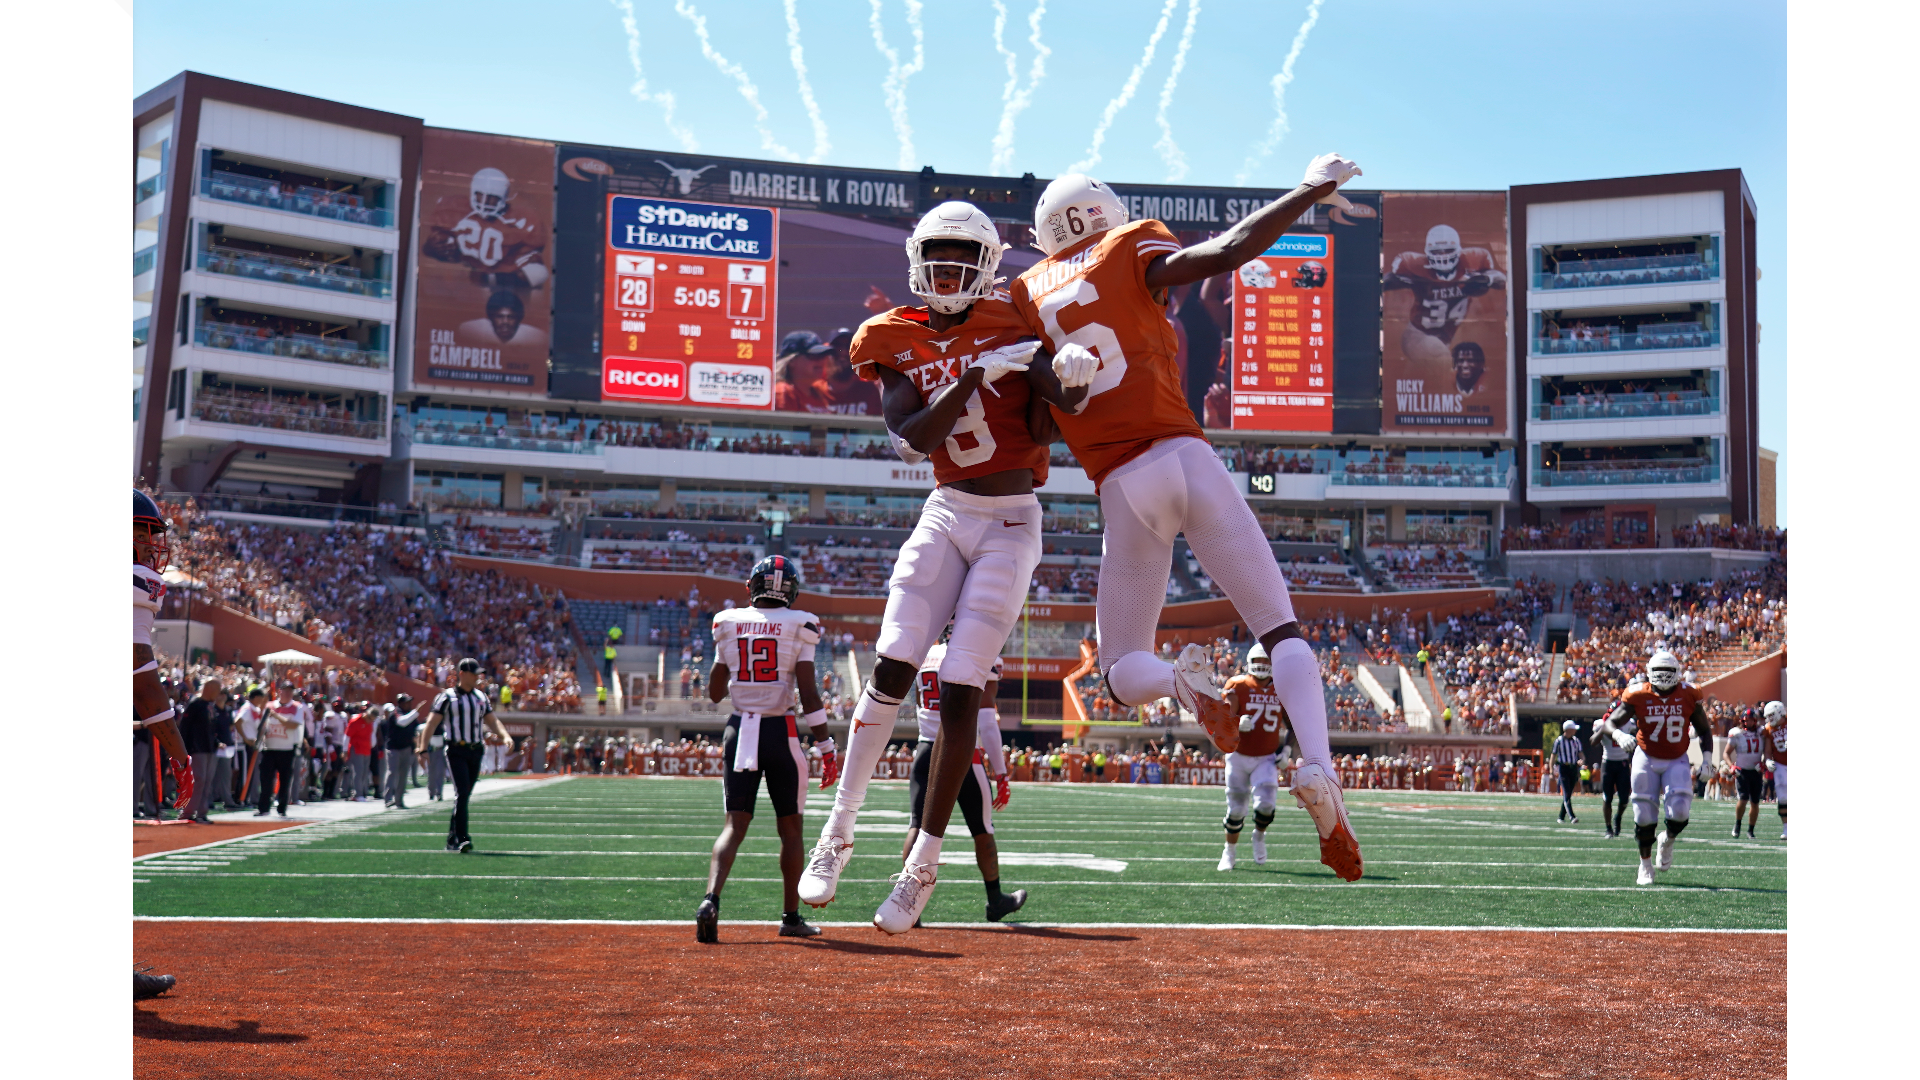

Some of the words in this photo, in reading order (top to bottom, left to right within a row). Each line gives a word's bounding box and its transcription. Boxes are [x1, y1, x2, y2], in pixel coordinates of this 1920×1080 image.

[729, 170, 821, 202] DARRELL
[826, 178, 840, 204] K
[846, 180, 910, 208] ROYAL
[1066, 206, 1085, 235] 6
[1225, 198, 1315, 225] STAM
[453, 219, 504, 266] 20
[1026, 242, 1099, 303] MOORE
[621, 278, 648, 306] 28
[674, 286, 721, 308] 5:05
[740, 287, 753, 314] 7
[1432, 286, 1463, 300] TEXA
[1421, 298, 1468, 329] 34
[621, 319, 646, 333] DOWN
[678, 324, 690, 336] TO
[689, 325, 702, 337] GO
[730, 327, 749, 340] BALL
[748, 329, 761, 341] ON
[430, 329, 456, 345] EARL
[628, 334, 638, 351] 3
[684, 338, 694, 355] 5
[1038, 278, 1128, 398] 6
[429, 344, 503, 370] CAMPBELL
[736, 342, 753, 359] 23
[1266, 348, 1300, 359] TURNOVERS
[903, 349, 993, 391] TEXA
[1267, 362, 1298, 373] PENALTIES
[608, 369, 679, 388] RICOH
[1396, 379, 1424, 393] RICKY
[1396, 393, 1463, 413] WILLIAMS
[928, 385, 997, 468] 8
[1251, 474, 1273, 493] 40
[736, 622, 782, 636] WILLIAMS
[737, 637, 779, 682] 12
[1038, 663, 1060, 673] FIELD
[1248, 693, 1280, 705] TEXAS
[1245, 703, 1281, 732] 75
[1646, 704, 1683, 716] TEXAS
[1644, 715, 1685, 743] 78
[1412, 747, 1454, 763] BEVO
[1746, 738, 1760, 754] 17
